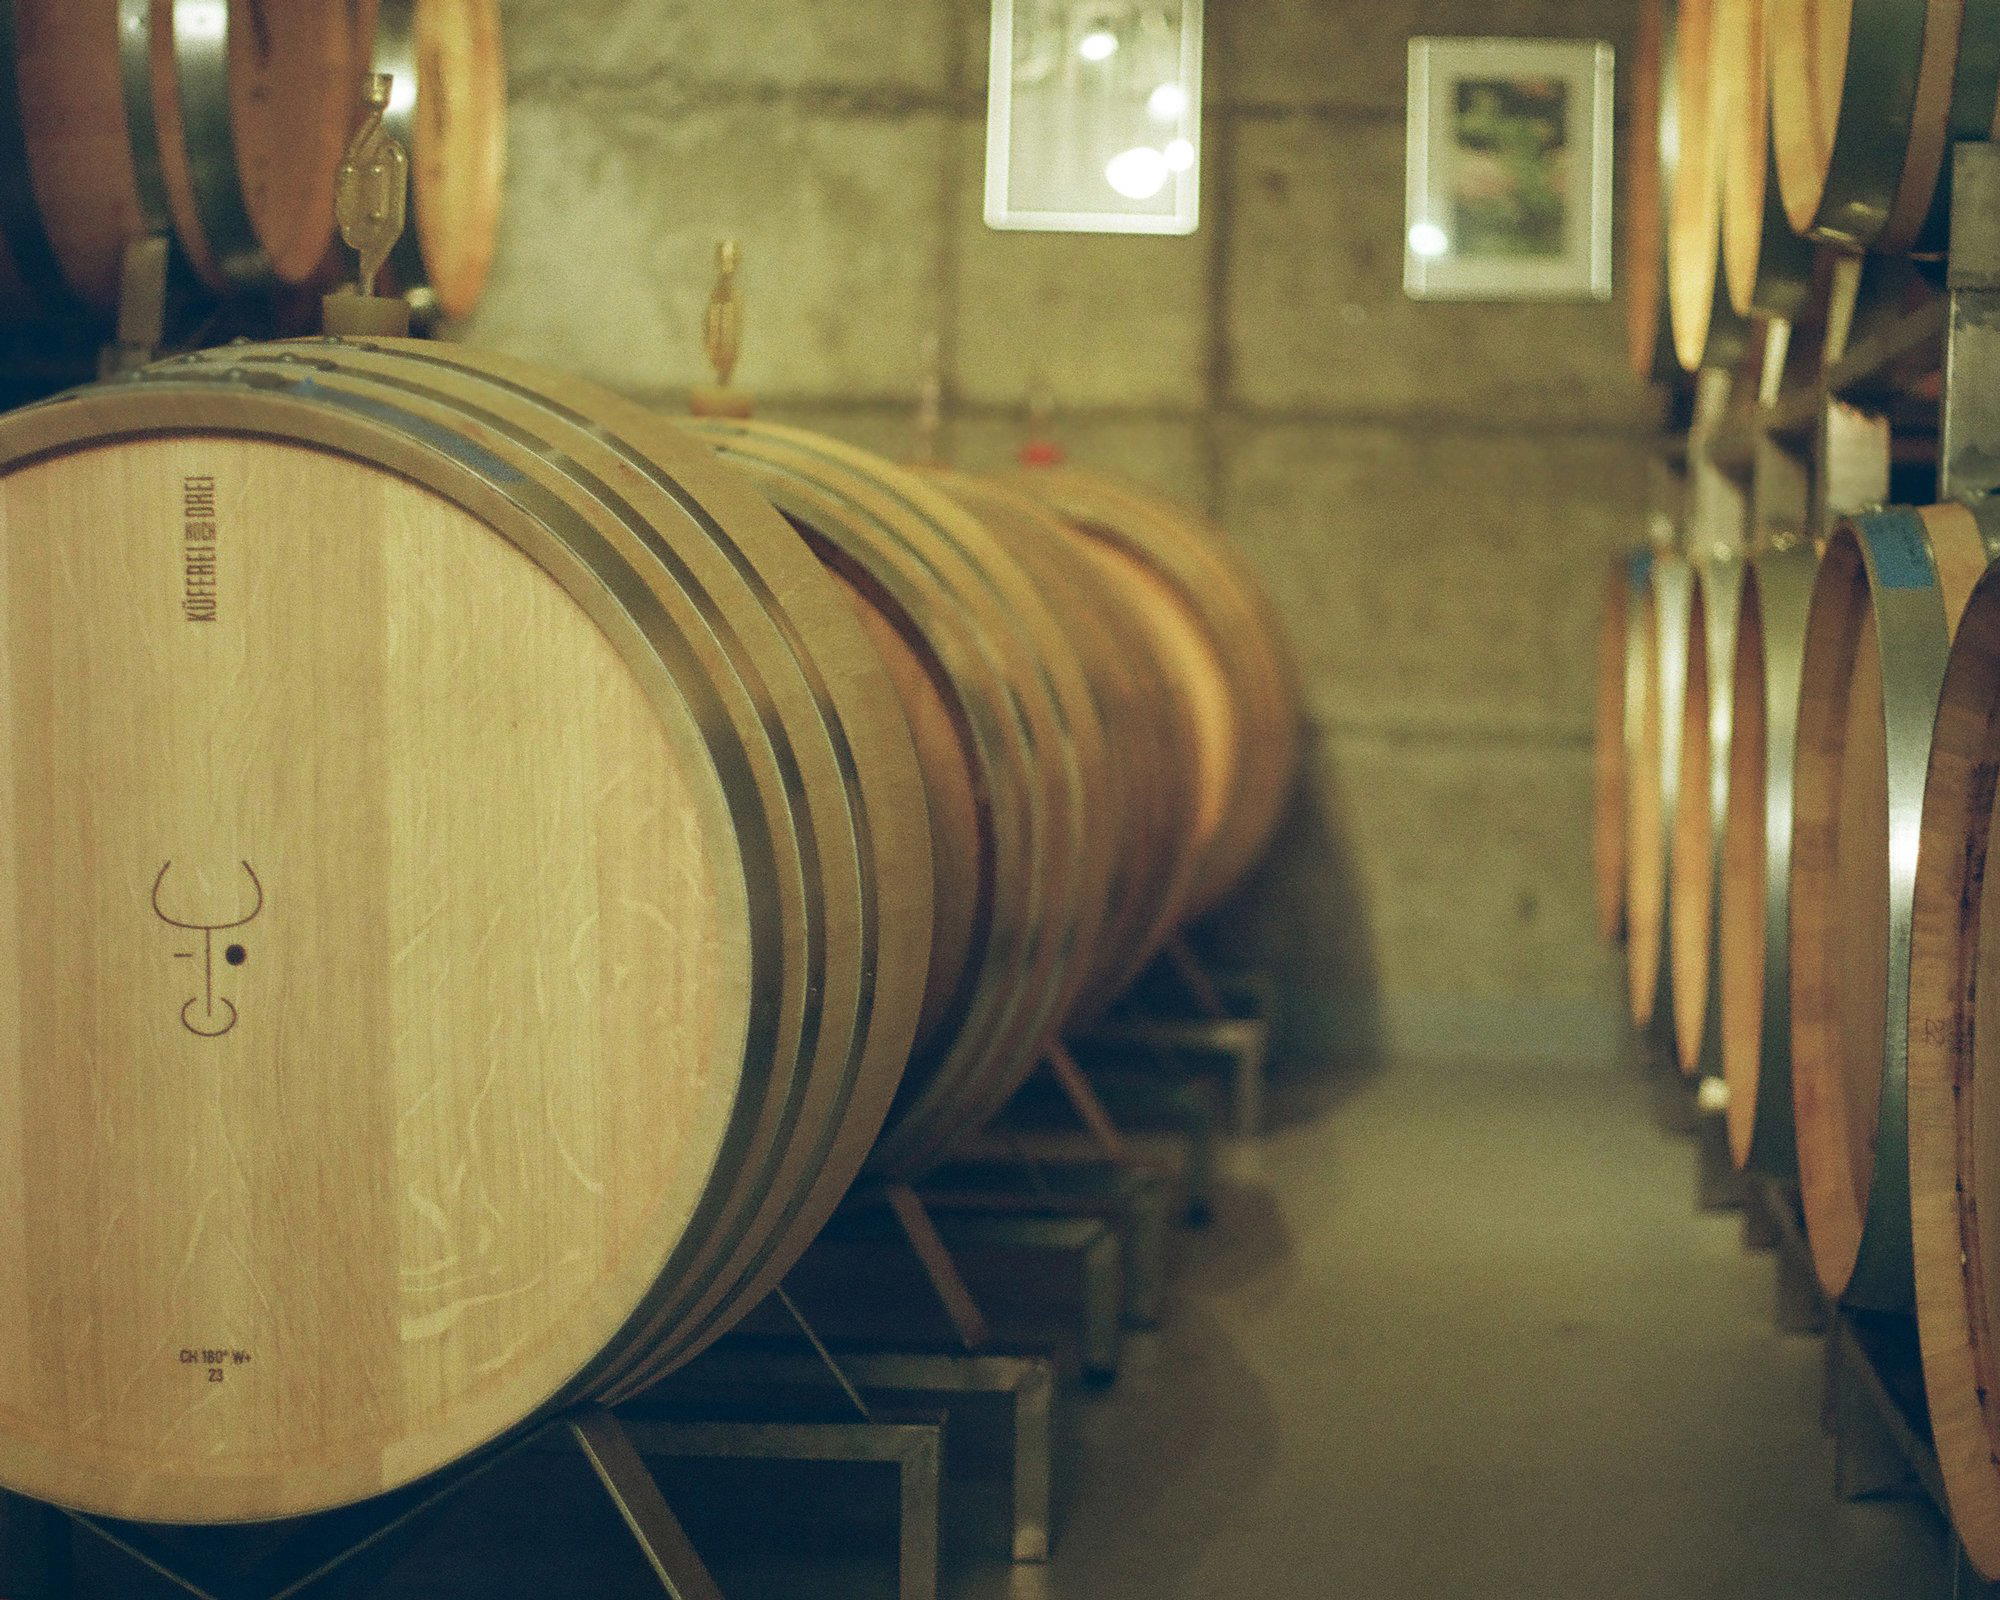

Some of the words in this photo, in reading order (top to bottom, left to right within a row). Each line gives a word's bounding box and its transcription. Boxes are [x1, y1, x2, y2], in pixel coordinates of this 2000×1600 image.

[184, 476, 215, 517] DREI
[182, 546, 216, 621] KÜFEREI
[179, 1349, 198, 1364] CH
[208, 1368, 224, 1382] 23
